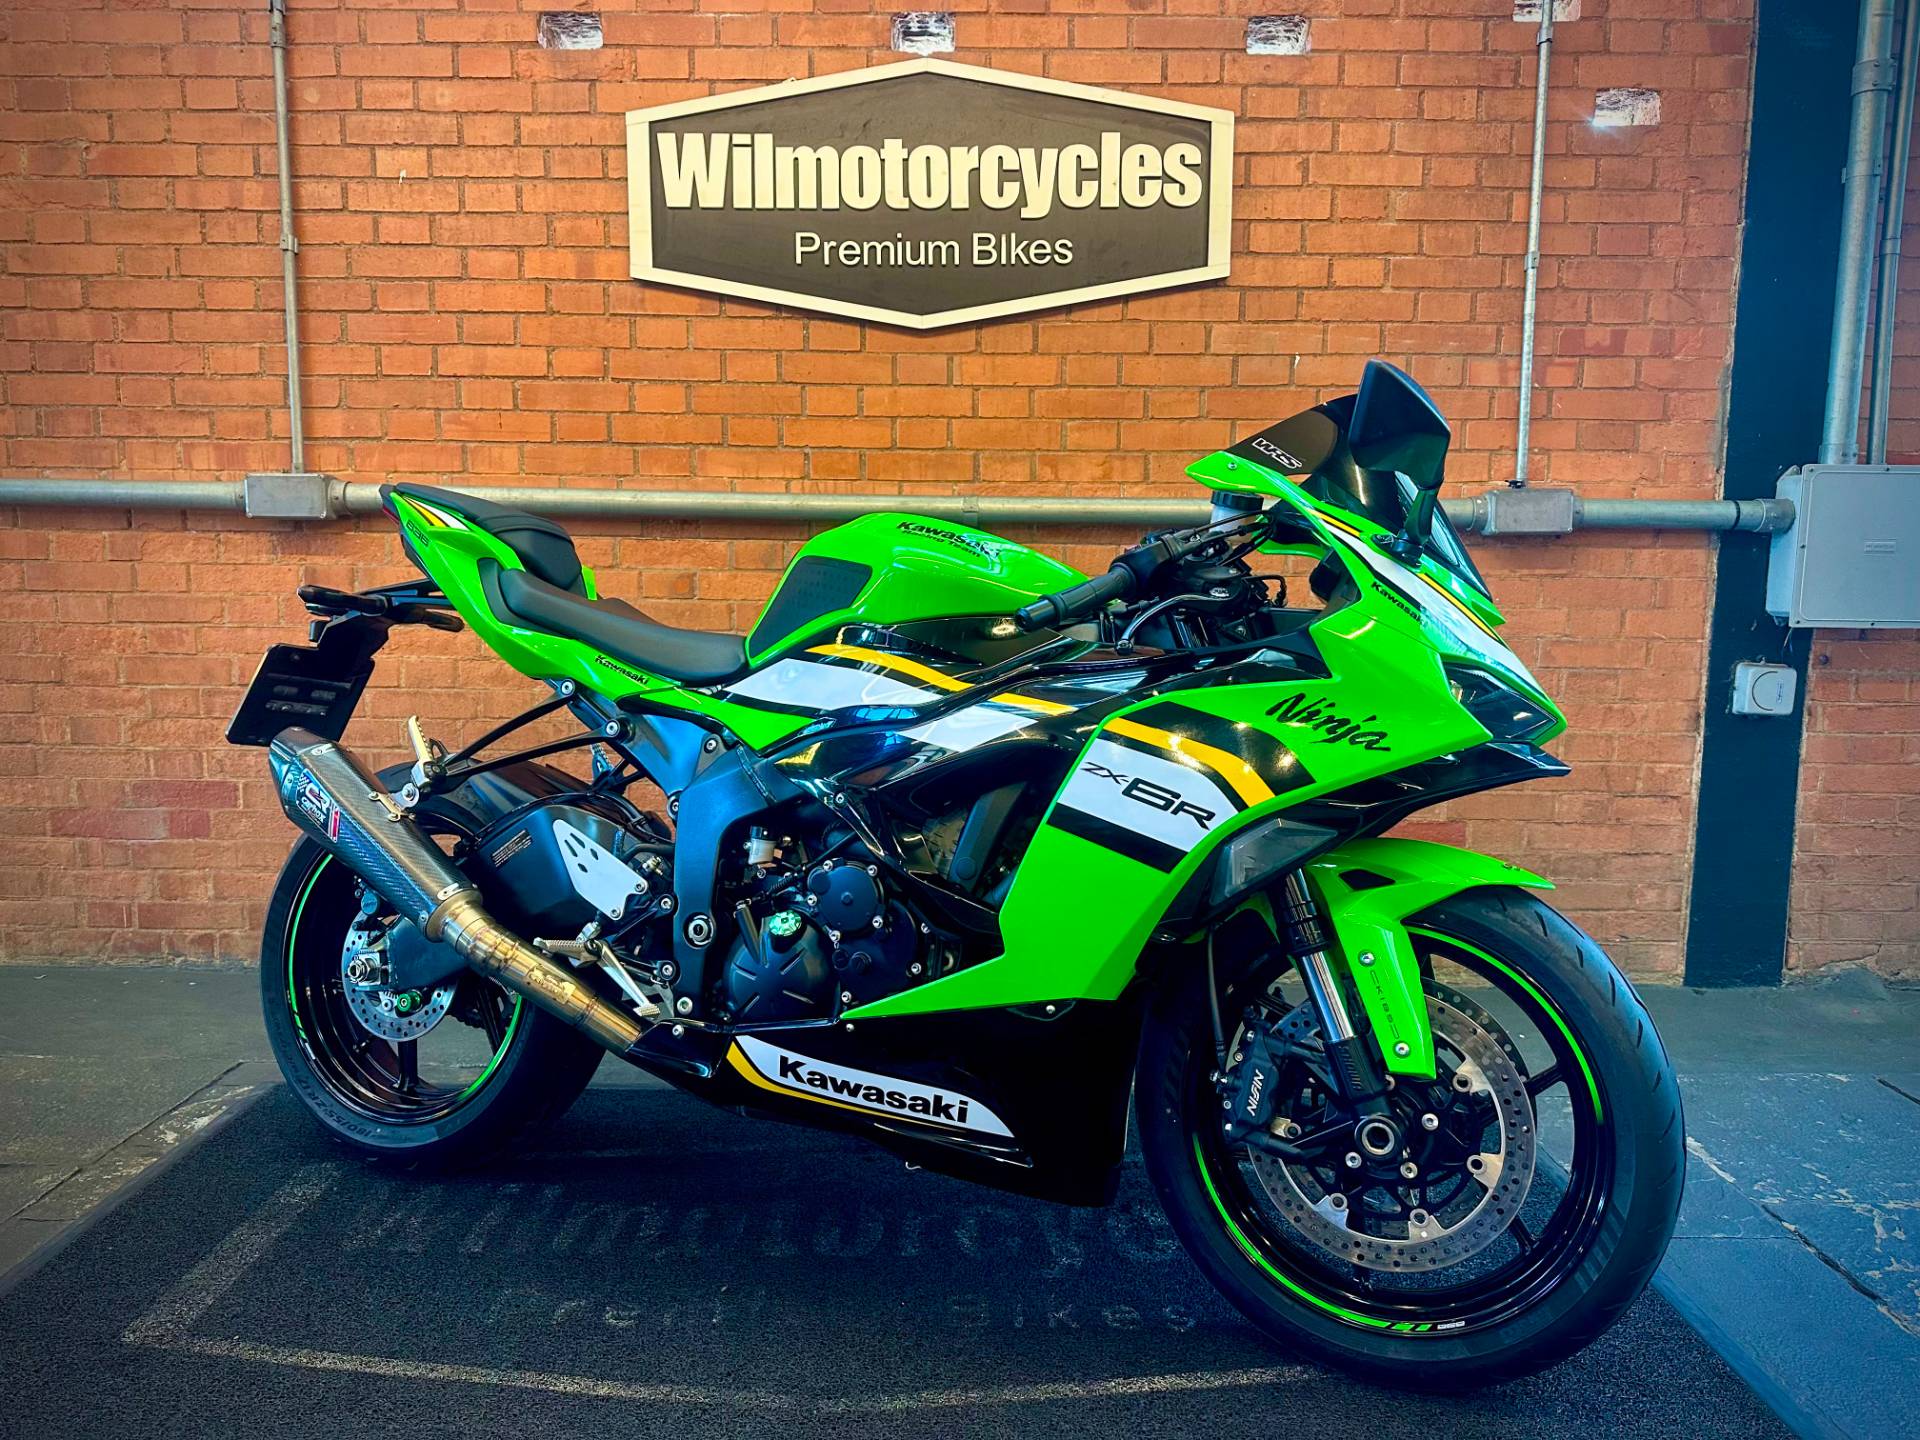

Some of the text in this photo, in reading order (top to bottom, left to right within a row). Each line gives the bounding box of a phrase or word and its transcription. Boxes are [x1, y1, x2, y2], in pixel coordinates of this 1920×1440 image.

[656, 131, 1204, 220] Wilmotorcycles
[794, 231, 961, 267] Premium
[594, 654, 650, 686] Kawasaki
[1264, 692, 1392, 752] Ninja
[778, 1054, 969, 1124] Kawasaki
